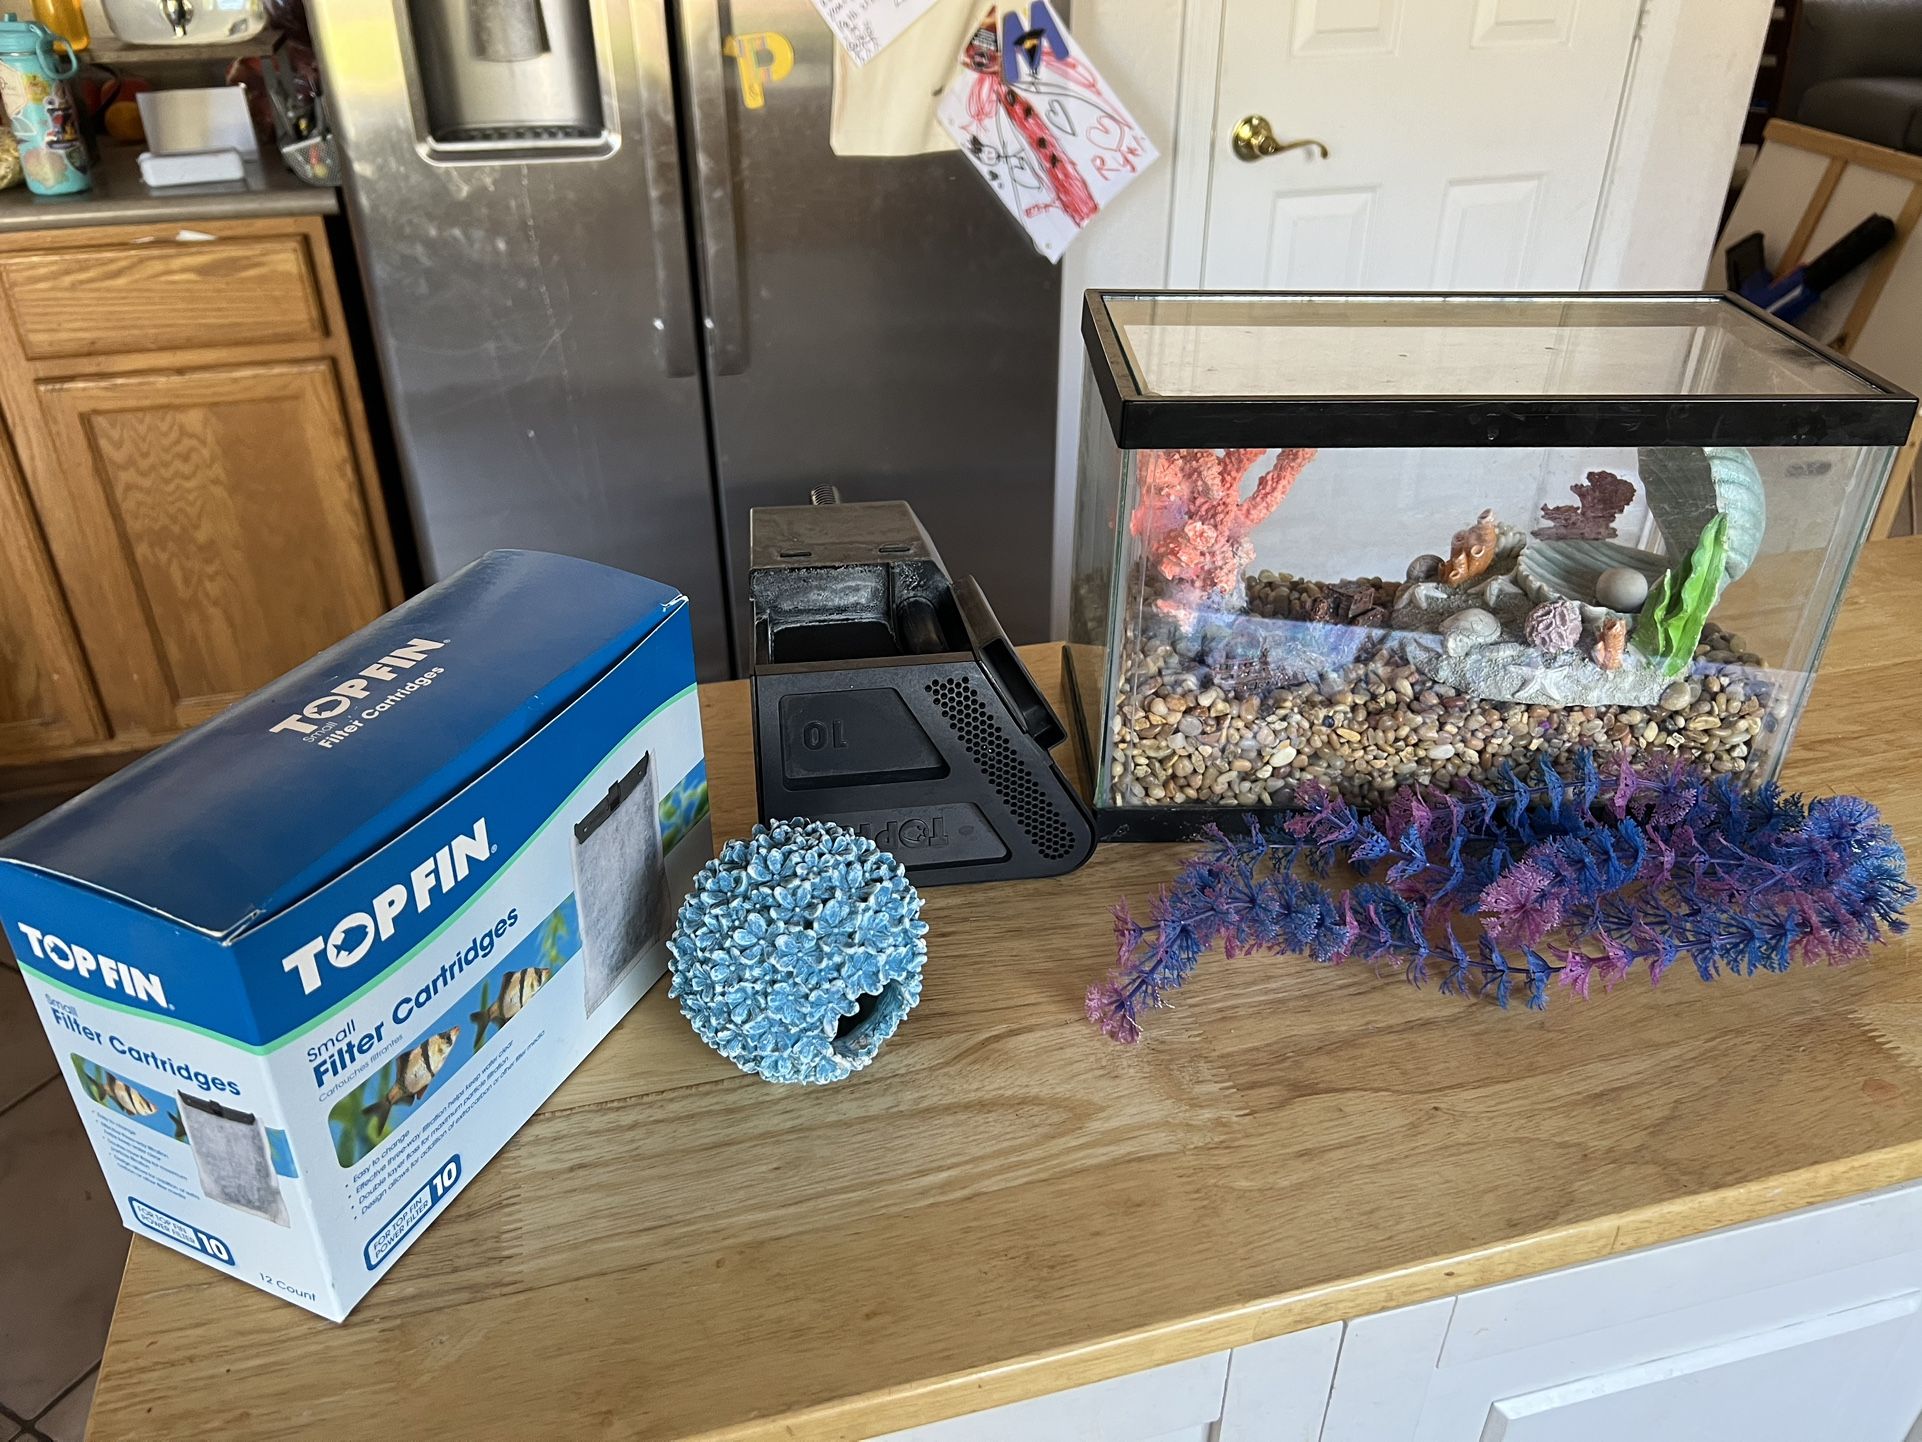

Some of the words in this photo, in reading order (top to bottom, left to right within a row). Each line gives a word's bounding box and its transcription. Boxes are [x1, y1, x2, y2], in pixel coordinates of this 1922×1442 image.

[723, 31, 795, 109] P
[302, 721, 338, 743] Small
[318, 720, 364, 748] Filter
[361, 666, 445, 719] Cartridges
[803, 720, 848, 750] 10
[45, 993, 78, 1017] Small
[313, 1021, 385, 1088] Filter
[391, 907, 519, 1026] Cartridges
[51, 1006, 103, 1046] Filter
[108, 1034, 241, 1096] Cartridges
[306, 1018, 356, 1063] Small
[318, 1061, 370, 1102] Cartouches
[370, 1033, 404, 1064] filtrantes
[355, 1164, 387, 1194] Effective
[387, 1133, 421, 1170] three-way
[422, 1106, 447, 1133] filtration
[447, 1087, 465, 1109] helps
[465, 1073, 481, 1091] keep
[481, 1056, 498, 1075] water
[498, 1039, 514, 1058] clear
[358, 1175, 387, 1205] Double
[387, 1157, 405, 1180] layer
[420, 1135, 430, 1147] for
[430, 1103, 463, 1138] maximum
[463, 1079, 487, 1107] particle
[486, 1056, 509, 1082] filtration
[361, 1188, 387, 1216] Design
[387, 1167, 410, 1190] allows
[410, 1156, 420, 1169] for
[420, 1129, 448, 1159] addition
[448, 1120, 455, 1132] of
[455, 1108, 471, 1125] extra
[470, 1084, 493, 1109] carbon
[492, 1075, 500, 1087] or
[500, 1060, 516, 1079] other
[515, 1048, 527, 1063] filter
[526, 1029, 546, 1052] media
[353, 1163, 371, 1183] Easy
[372, 1156, 381, 1167] to
[381, 1129, 410, 1159] change
[432, 1161, 457, 1197] 10
[196, 1231, 229, 1261] 10
[373, 1229, 391, 1251] FOR
[392, 1212, 409, 1231] TOP
[409, 1196, 422, 1215] FIN
[375, 1225, 405, 1259] POWER
[406, 1200, 429, 1227] FILTER
[259, 1272, 274, 1285] 12
[276, 1280, 317, 1302] Count
